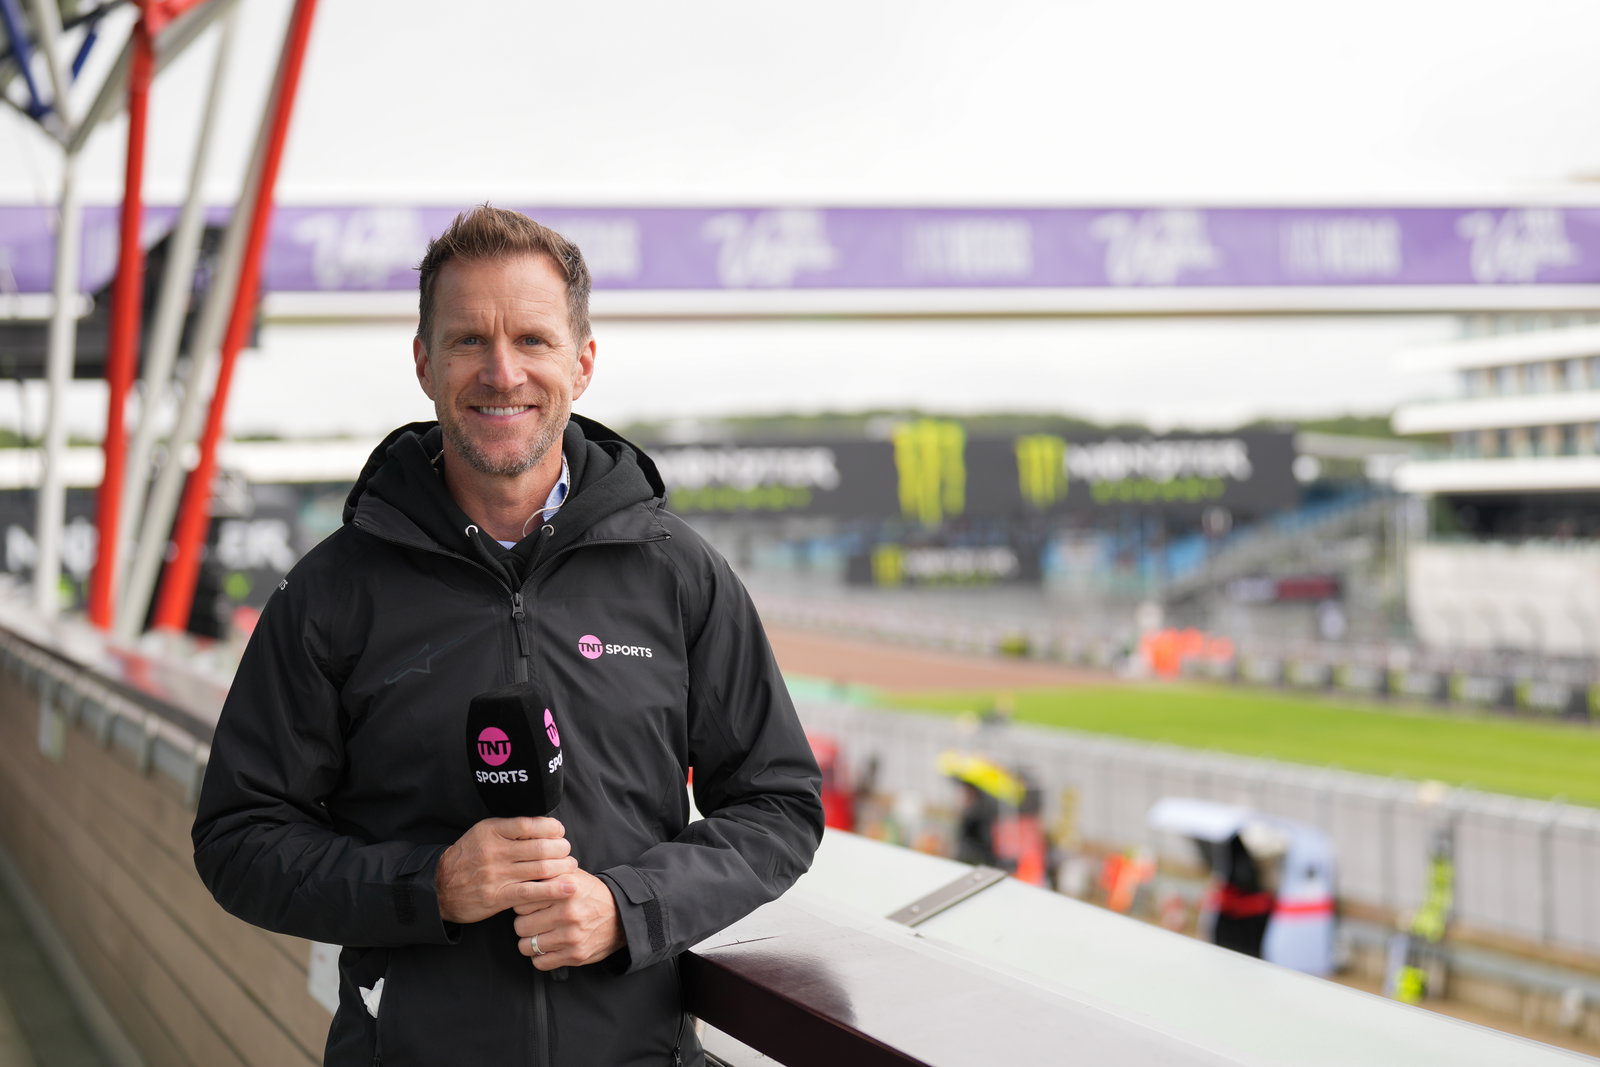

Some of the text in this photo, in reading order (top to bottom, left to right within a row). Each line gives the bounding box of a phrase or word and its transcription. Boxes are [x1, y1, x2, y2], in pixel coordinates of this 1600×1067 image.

[605, 644, 653, 658] SPORTS
[478, 740, 511, 756] TNT
[548, 748, 563, 774] SPO
[475, 769, 529, 784] SPORTS
